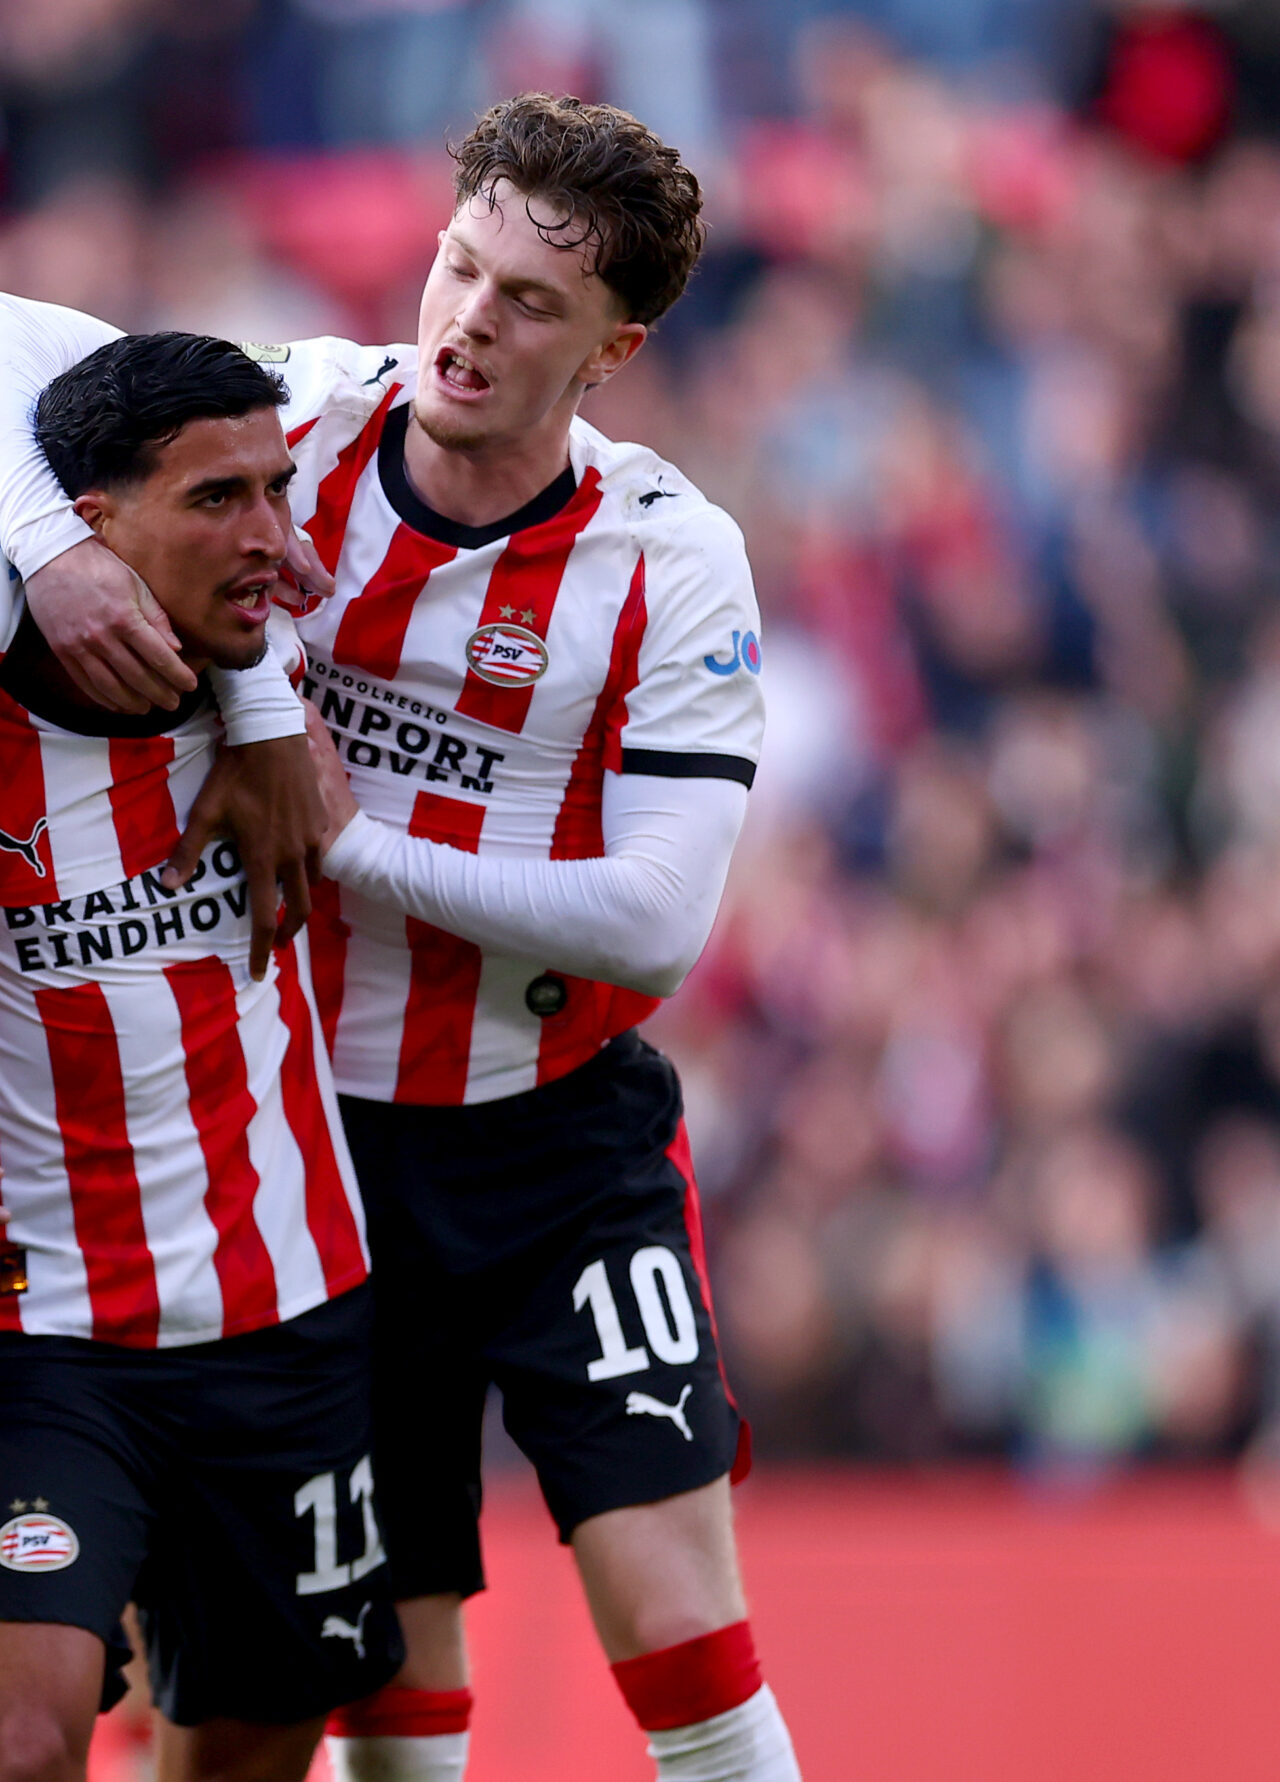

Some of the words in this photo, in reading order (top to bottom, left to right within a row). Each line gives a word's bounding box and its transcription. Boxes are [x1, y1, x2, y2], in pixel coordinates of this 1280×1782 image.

[492, 643, 524, 661] PSV
[303, 676, 504, 779] INPORT
[3, 843, 243, 929] BRAINPO
[14, 880, 250, 972] EINDHOV
[572, 1245, 699, 1382] 10
[22, 1535, 49, 1548] PSV
[294, 1454, 387, 1596] 11
